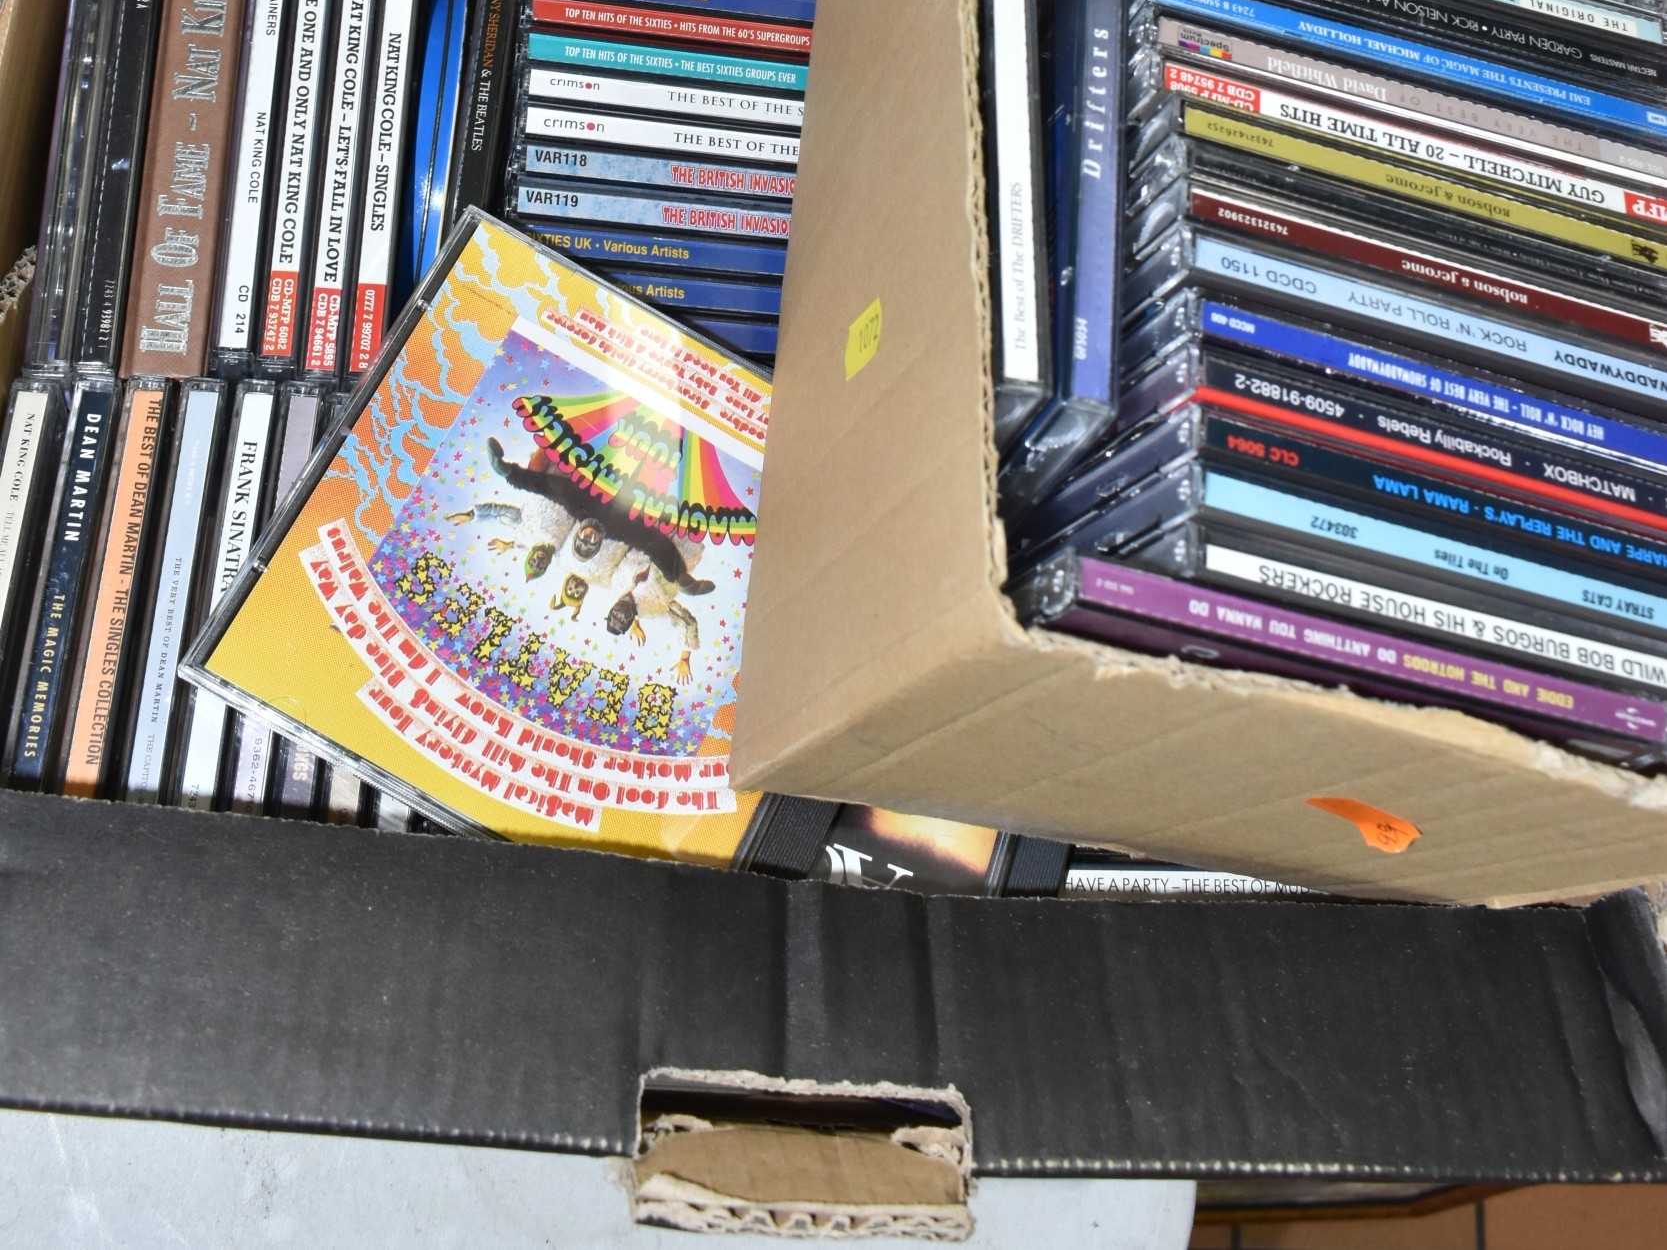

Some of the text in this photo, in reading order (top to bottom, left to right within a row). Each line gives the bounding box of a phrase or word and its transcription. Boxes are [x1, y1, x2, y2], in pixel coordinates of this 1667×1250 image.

[301, 11, 317, 42] ONE
[482, 12, 500, 68] SHERIDAN
[297, 48, 314, 81] AND
[481, 69, 493, 77] &
[293, 85, 310, 126] ONLY
[478, 81, 491, 101] THE
[1082, 27, 1110, 179] Drifters
[471, 105, 488, 151] BEATLES
[289, 132, 306, 167] NAT
[535, 150, 587, 167] VAR118
[1280, 103, 1604, 204] GUY MITCHELL 20 ALL TIME HITS
[284, 171, 302, 213] KING
[526, 190, 578, 207] VAR119
[279, 219, 298, 264] COLE
[1347, 291, 1402, 319] PARTY
[1405, 306, 1450, 332] ROLL
[1482, 326, 1526, 352] ROCK
[64, 414, 102, 541] DEAN MARTIN
[221, 442, 257, 592] FRANK SINATRA
[1259, 565, 1618, 673] BOB BURGOS & HIS HOUSE ROCKERS
[24, 595, 65, 757] THE MAGIC MEMORIES
[1109, 877, 1118, 892] A
[1122, 877, 1169, 892] PARTY
[1182, 877, 1210, 892] THE
[1214, 878, 1249, 893] BEST
